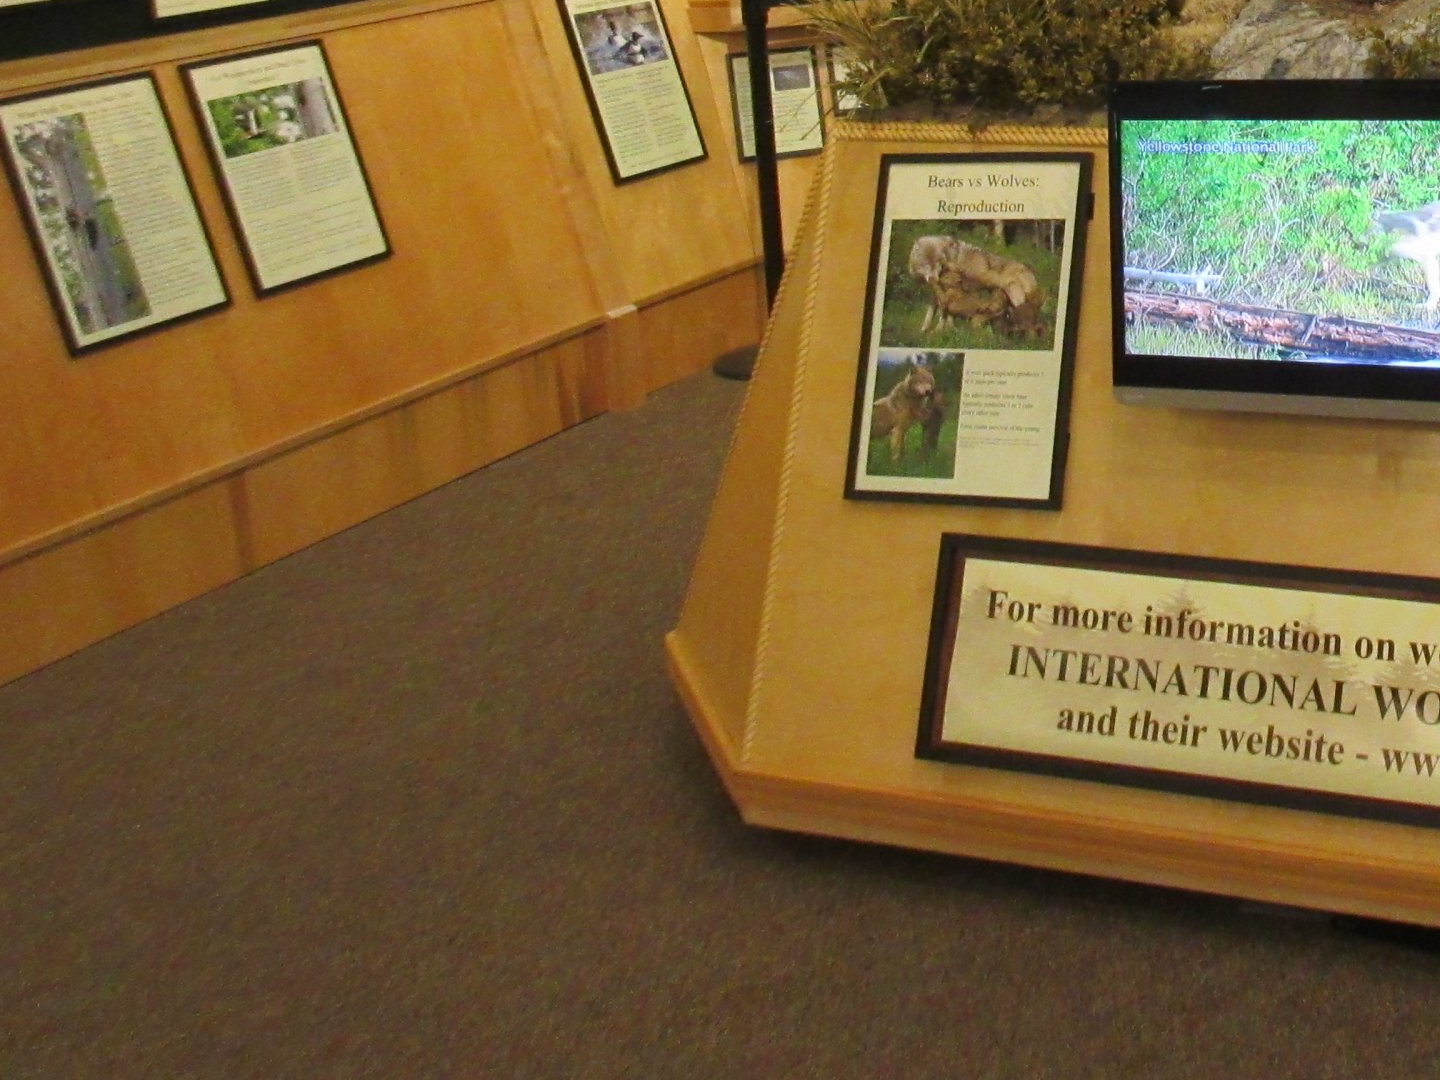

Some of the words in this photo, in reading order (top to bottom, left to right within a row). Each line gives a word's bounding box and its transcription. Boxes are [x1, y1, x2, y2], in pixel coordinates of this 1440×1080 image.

[1138, 141, 1220, 152] Yellowstone
[1224, 141, 1280, 152] National
[1285, 141, 1315, 152] Park
[928, 174, 964, 188] Bears
[967, 178, 983, 188] vs
[987, 174, 1040, 188] Wolves:
[937, 199, 1025, 216] Reproduction
[986, 590, 1042, 626] For
[1052, 607, 1133, 635] more
[1143, 606, 1342, 657] information
[1354, 638, 1397, 663] on
[1006, 646, 1358, 716] INTERNATIONAL
[1057, 705, 1118, 738] and
[1127, 708, 1208, 749] their
[1218, 724, 1346, 765] website
